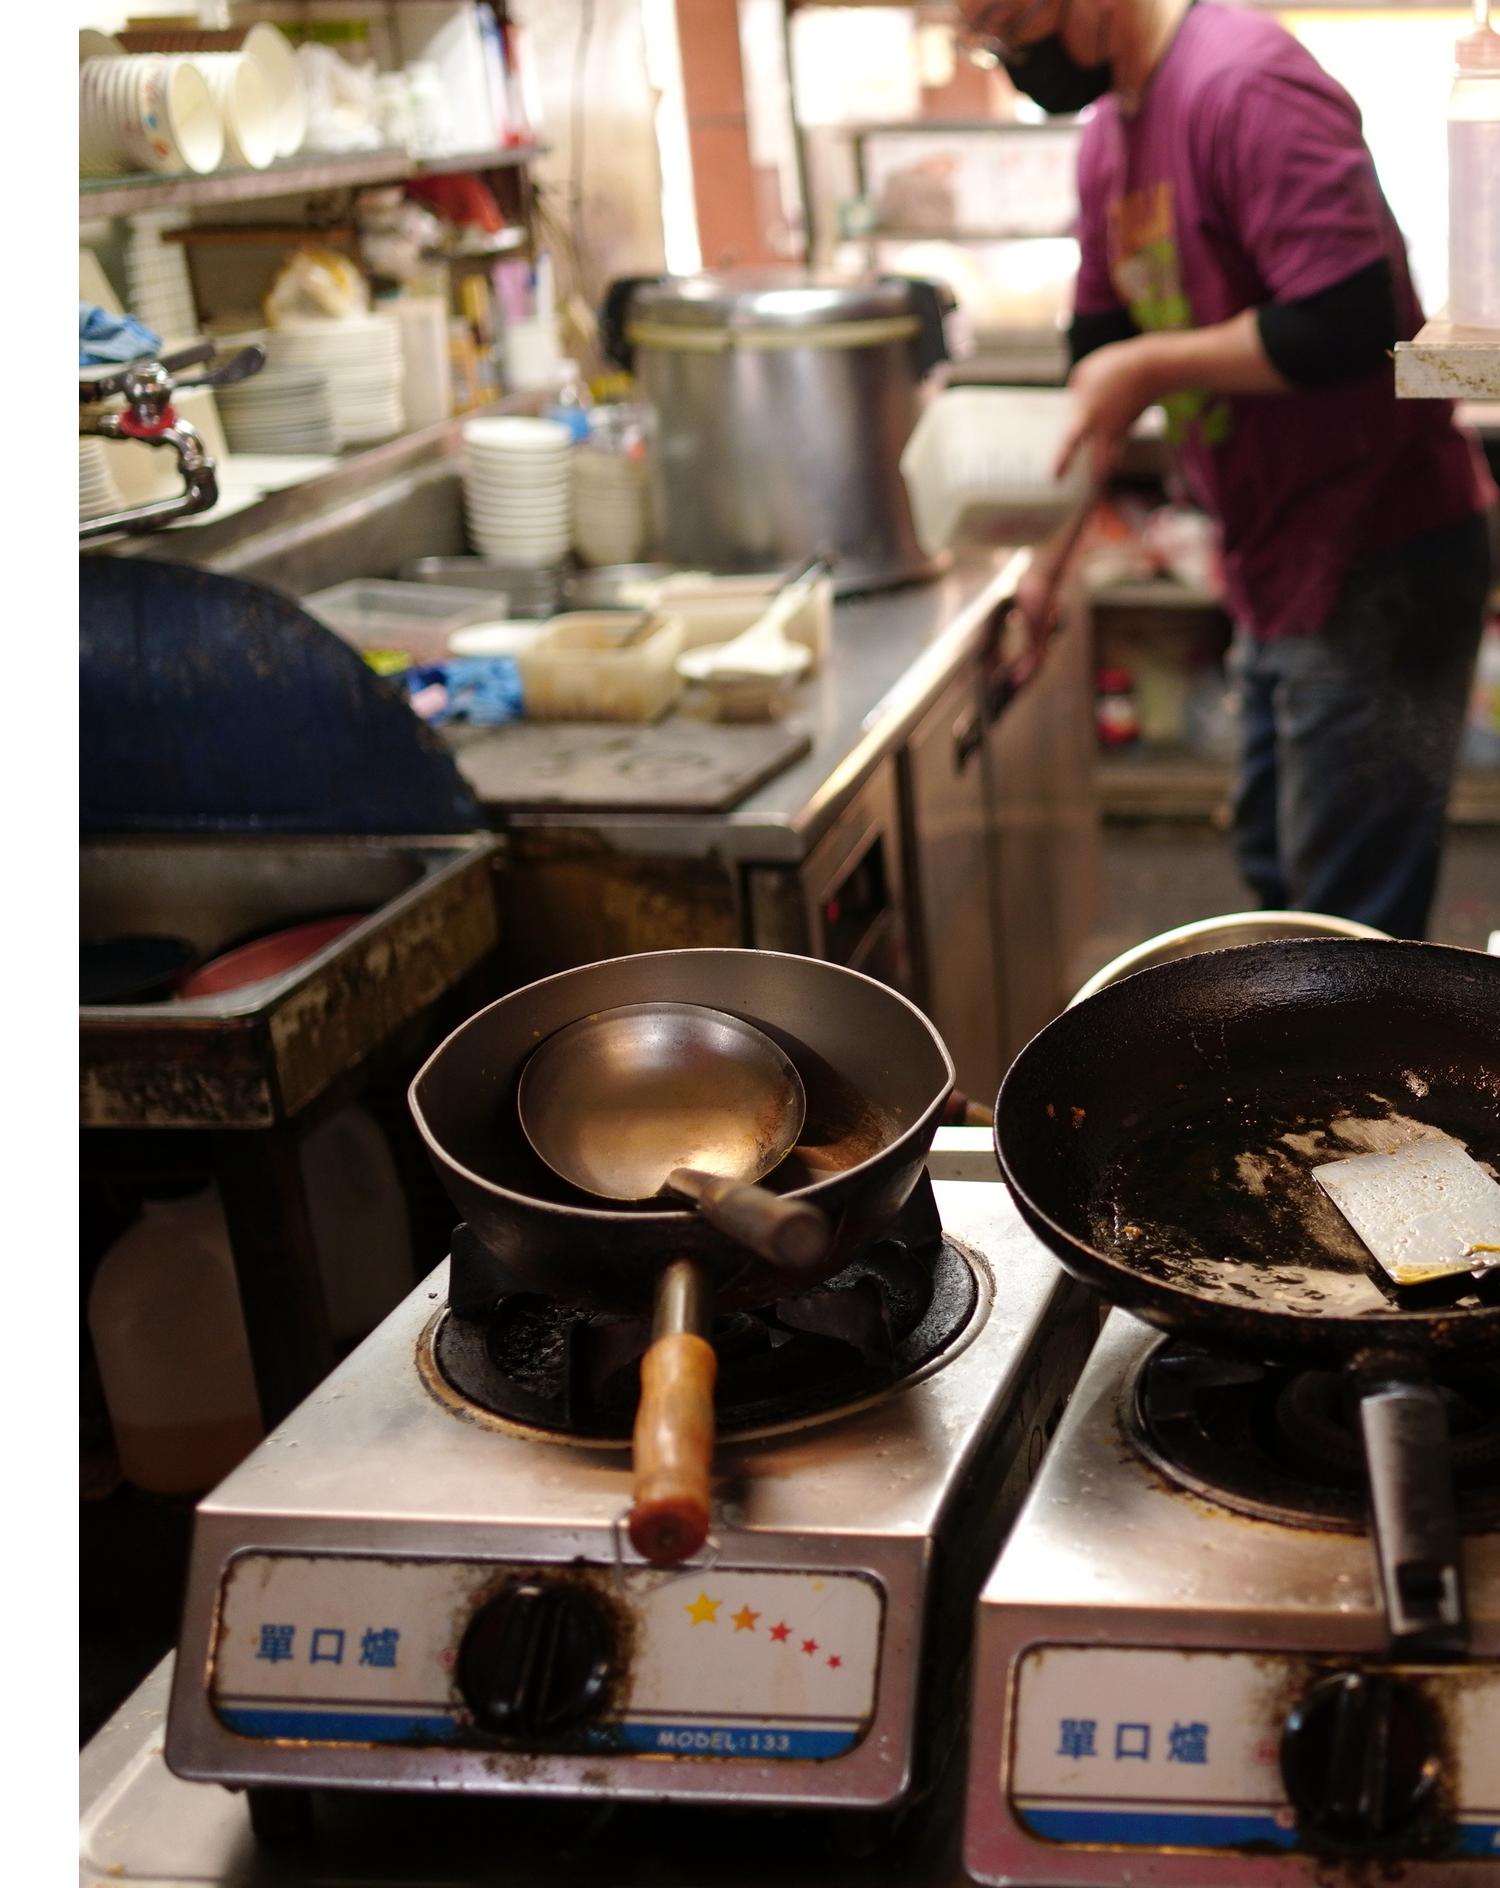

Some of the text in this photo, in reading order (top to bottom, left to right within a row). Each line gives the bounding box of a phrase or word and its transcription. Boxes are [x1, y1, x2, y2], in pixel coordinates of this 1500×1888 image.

[255, 1623, 400, 1668] 單口爐
[656, 1730, 790, 1752] MODEL:133
[1056, 1718, 1209, 1764] 單口爐
